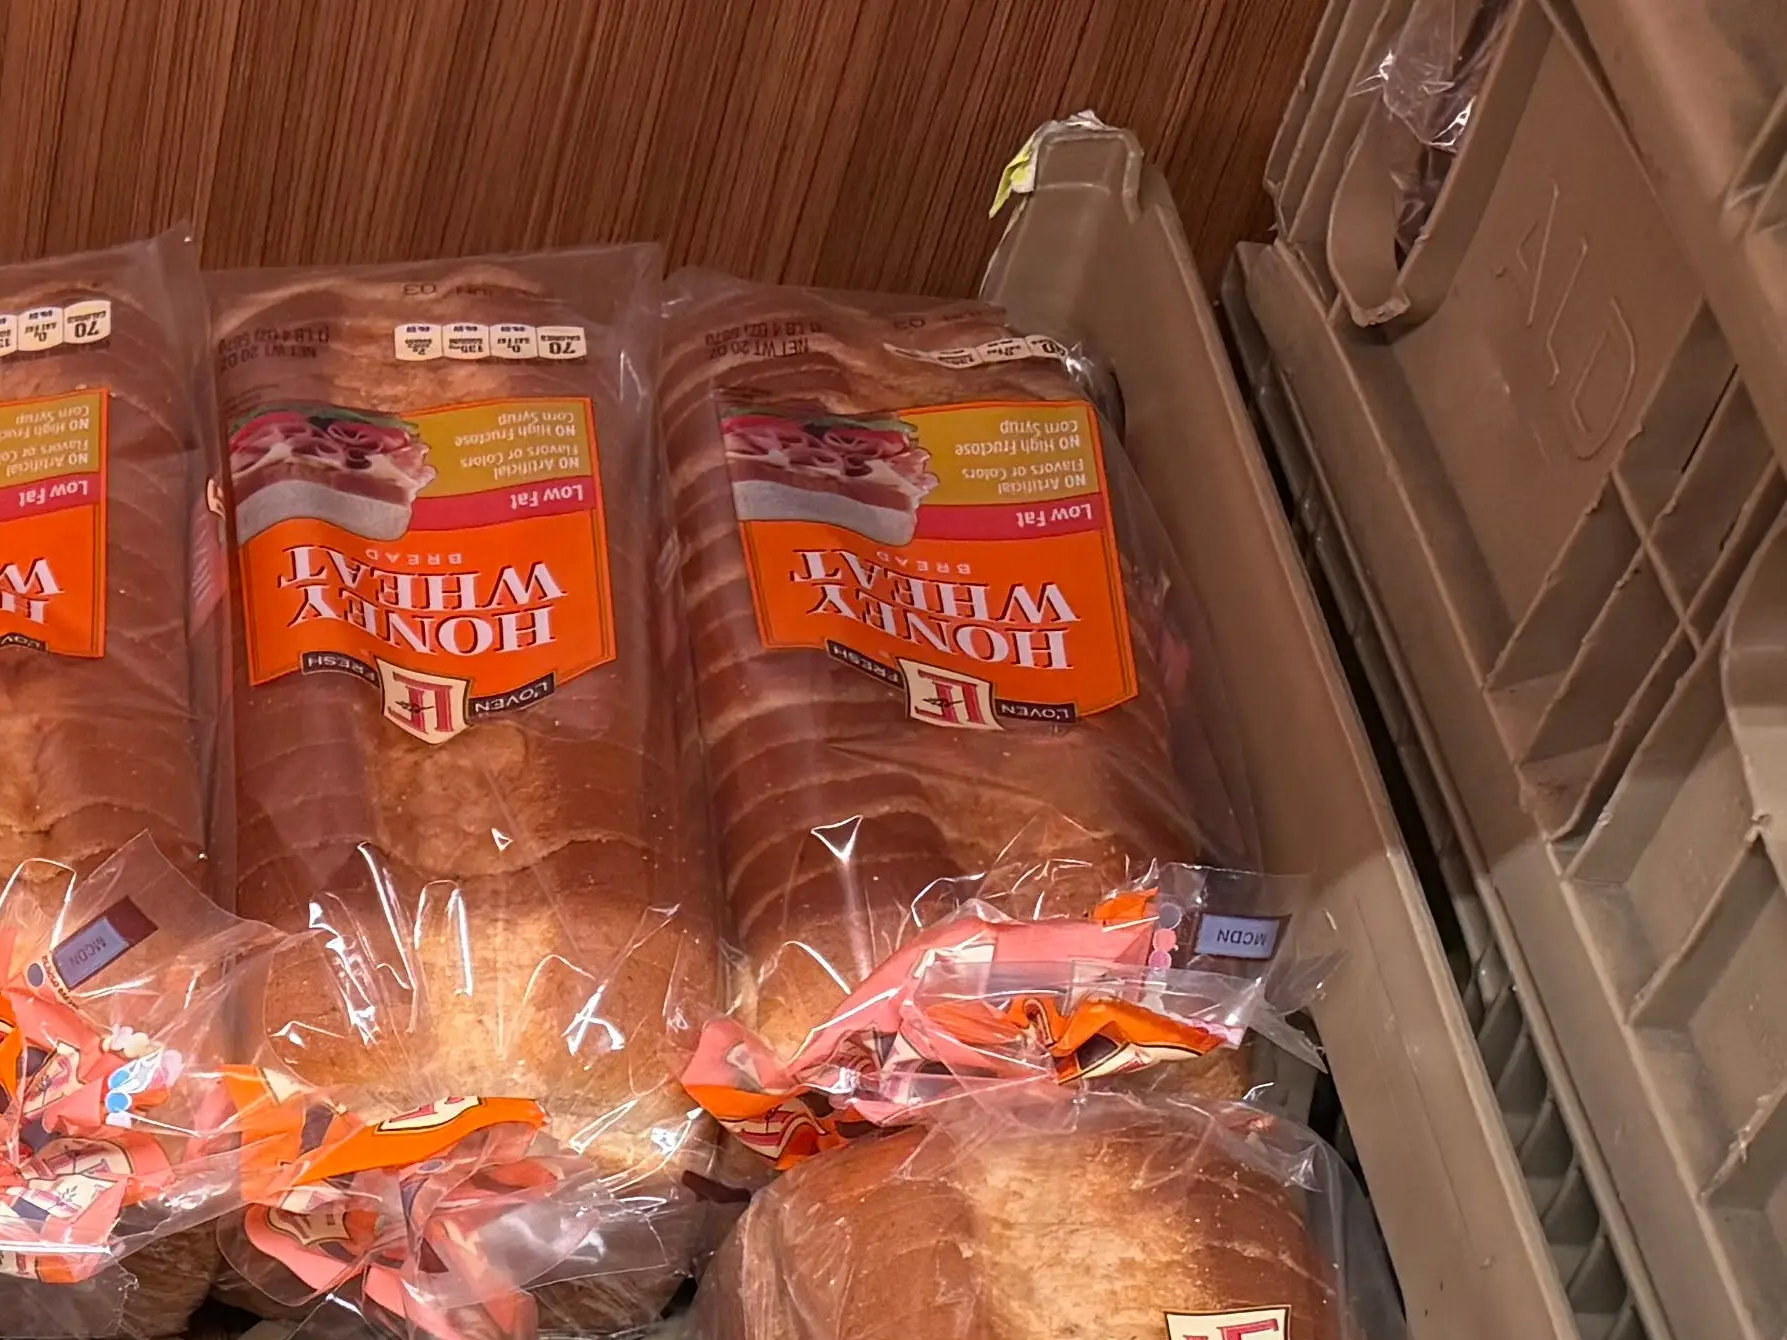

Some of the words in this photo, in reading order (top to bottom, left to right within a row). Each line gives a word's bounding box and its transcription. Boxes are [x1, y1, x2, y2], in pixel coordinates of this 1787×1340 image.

[74, 322, 99, 339] 70
[548, 342, 576, 355] 70
[730, 340, 750, 355] 20
[754, 339, 776, 356] WT
[776, 338, 808, 357] NET
[15, 410, 53, 425] Syrup
[58, 404, 90, 421] Corn
[498, 410, 539, 426] Syrup
[542, 411, 575, 423] Corn
[33, 422, 65, 436] High
[68, 418, 90, 431] NO
[517, 423, 551, 439] High
[554, 425, 576, 438] NO
[999, 420, 1041, 437] Syrup
[1044, 420, 1078, 436] Corn
[39, 438, 89, 453] Flavors
[454, 431, 514, 447] Fructose
[1020, 437, 1055, 452] High
[1059, 434, 1080, 449] NO
[22, 446, 36, 457] or
[508, 448, 523, 460] or
[526, 444, 578, 455] Flavors
[955, 440, 1016, 456] Fructose
[7, 455, 65, 477] Artificial
[68, 452, 89, 465] NO
[460, 453, 503, 468] Colors
[558, 457, 579, 469] NO
[493, 459, 554, 480] Artificial
[962, 468, 1007, 480] Colors
[1010, 466, 1026, 478] or
[1030, 458, 1084, 476] Flavors
[997, 476, 1060, 494] Artificial
[1064, 473, 1087, 487] NO
[19, 488, 45, 507] Fat
[50, 480, 89, 500] Low
[544, 484, 583, 503] Low
[510, 491, 538, 509] Fat
[1015, 510, 1045, 528] Fat
[1051, 503, 1092, 522] Low
[364, 549, 462, 565] BREAD
[875, 550, 971, 575] BREAD
[278, 544, 567, 613] WHEAT
[788, 549, 1081, 624] WHEAT
[286, 584, 556, 658] HONEY
[806, 583, 1074, 671] HONEY
[473, 680, 550, 714] L'OVEN
[1000, 703, 1069, 720] L'OVEN
[1216, 929, 1267, 946] MCDN
